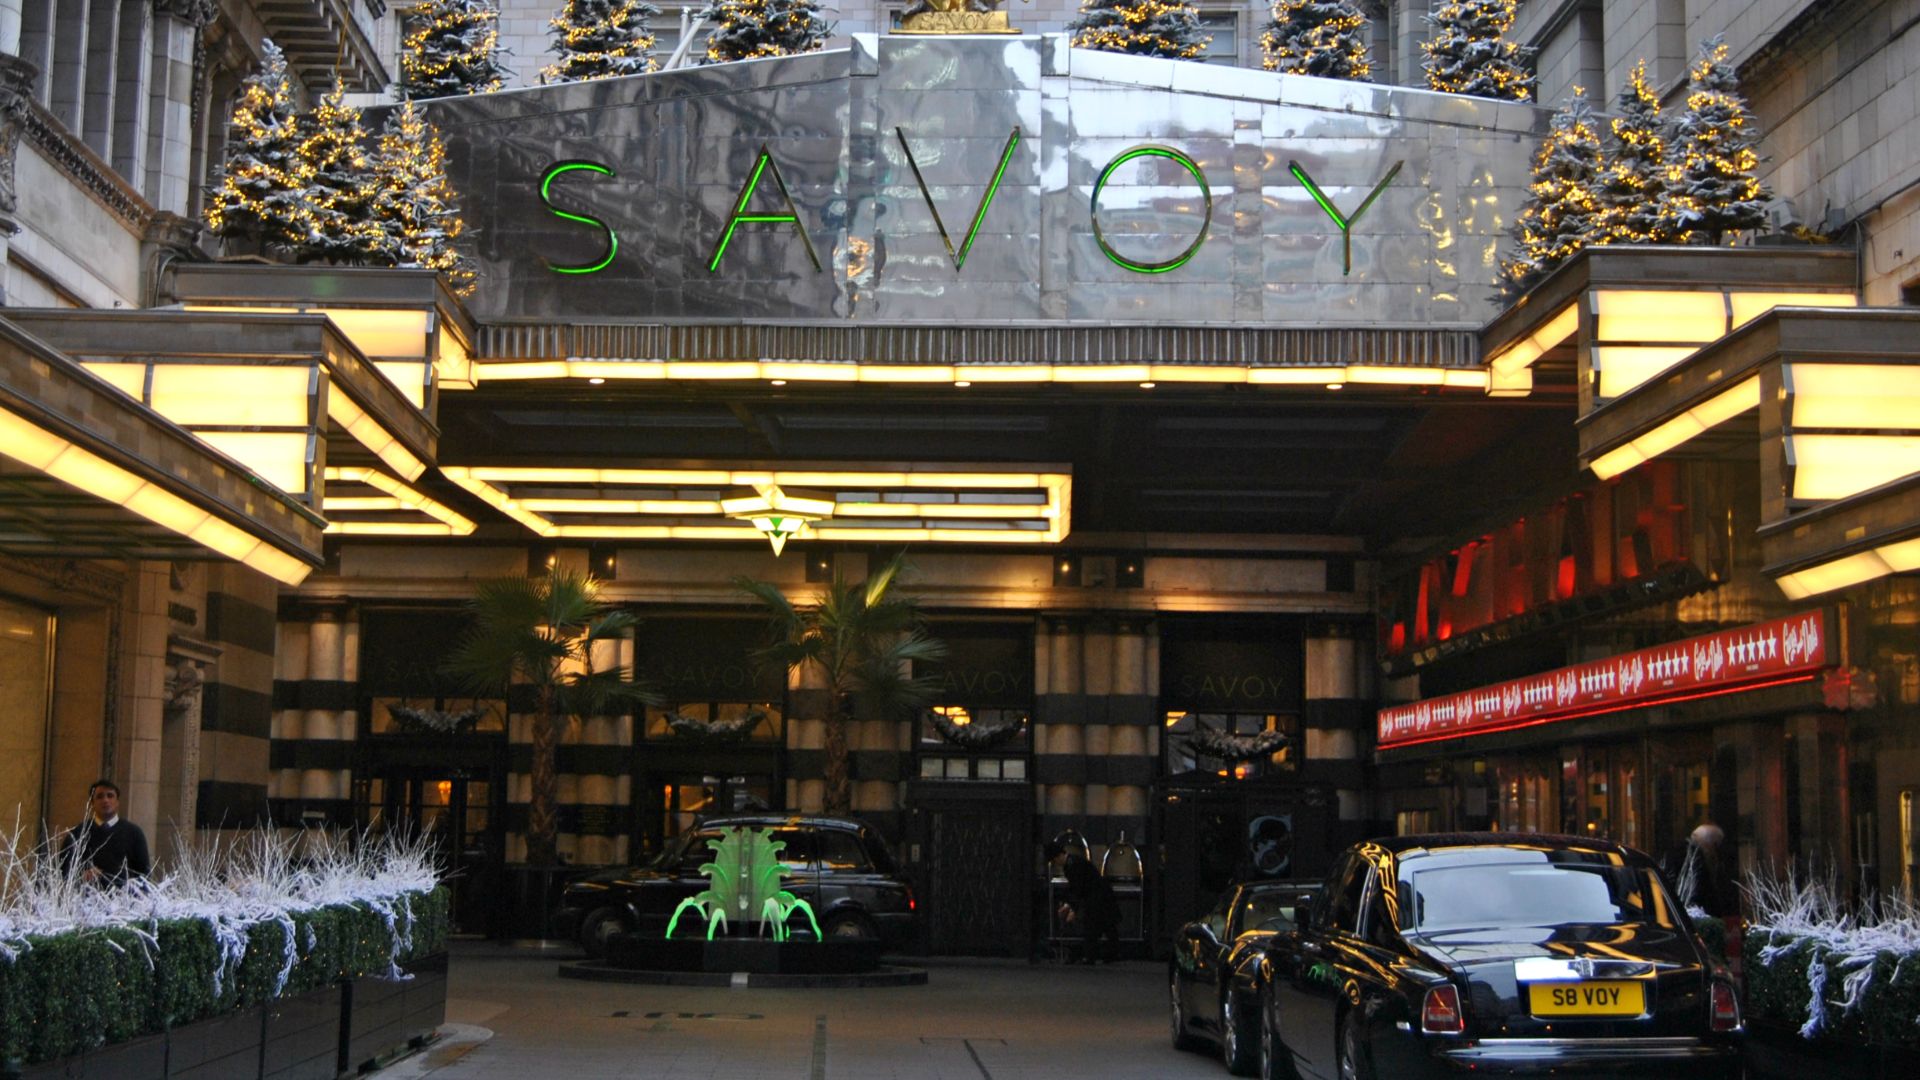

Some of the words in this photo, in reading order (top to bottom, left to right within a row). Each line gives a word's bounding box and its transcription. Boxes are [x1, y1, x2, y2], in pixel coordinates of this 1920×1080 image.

[920, 12, 995, 30] SAVOY
[538, 126, 1403, 275] SAVOY
[1180, 674, 1284, 699] SAVOY
[1552, 987, 1578, 1006] S8
[1582, 987, 1620, 1006] VOY
